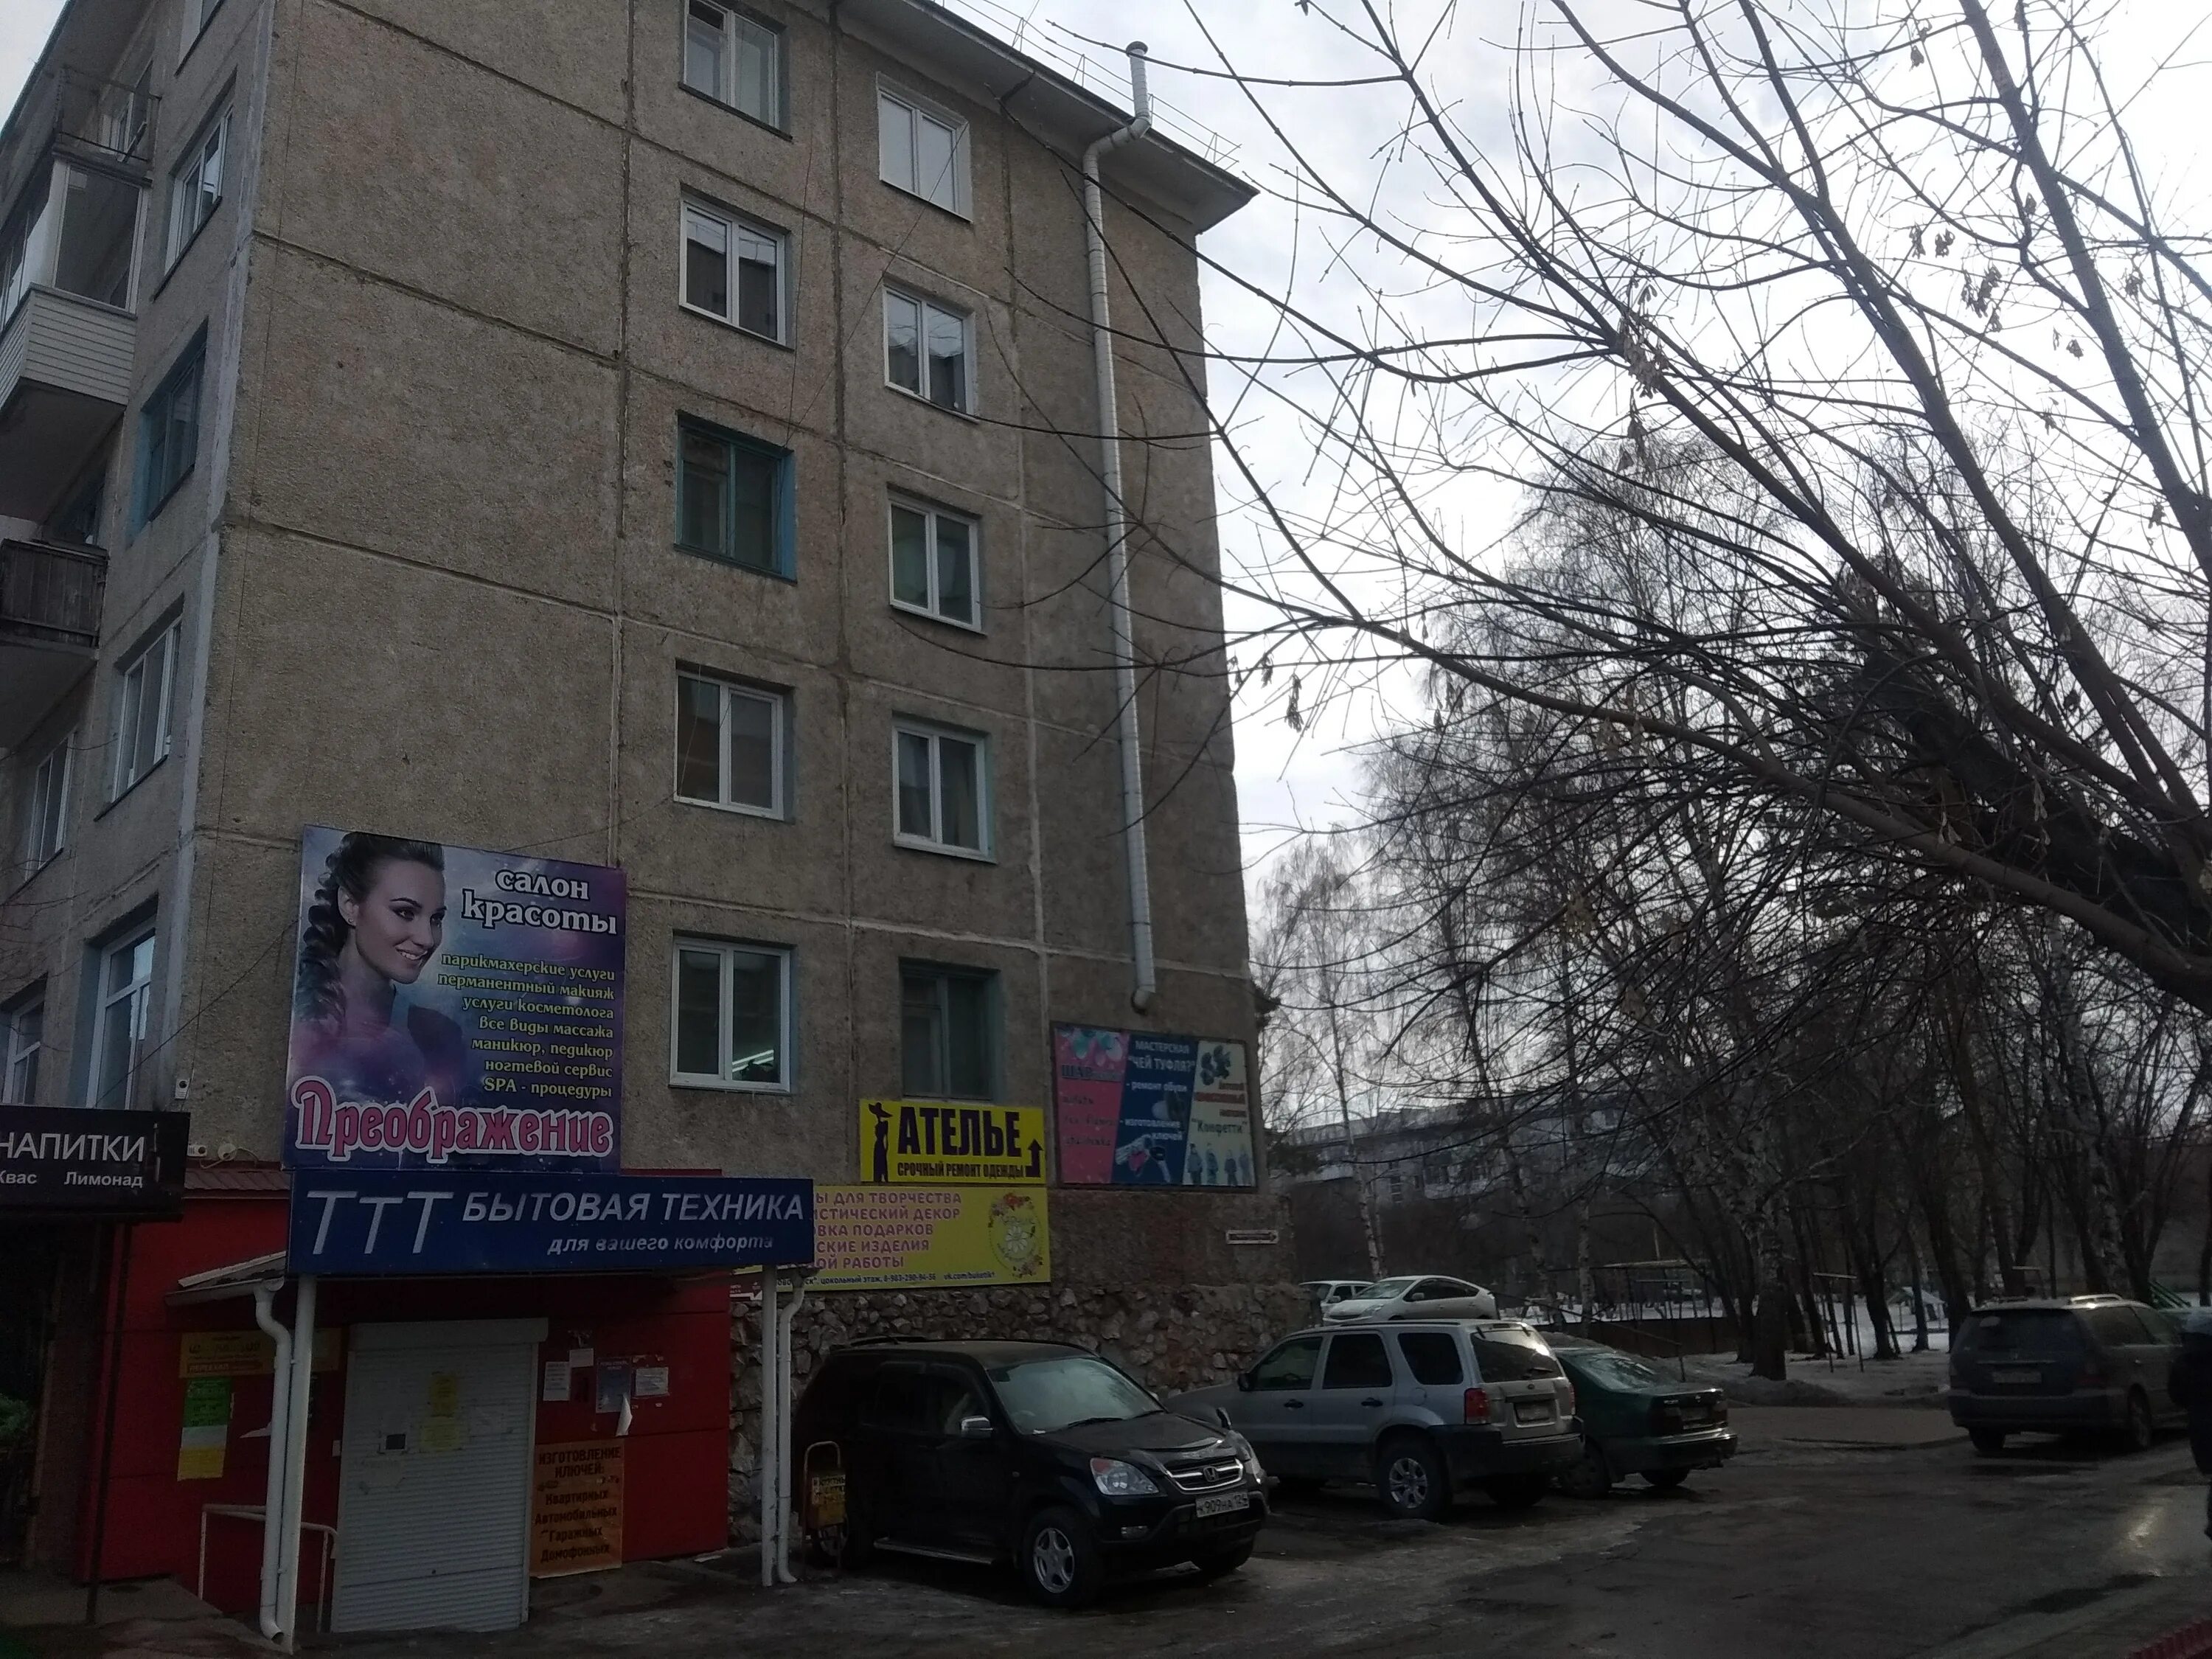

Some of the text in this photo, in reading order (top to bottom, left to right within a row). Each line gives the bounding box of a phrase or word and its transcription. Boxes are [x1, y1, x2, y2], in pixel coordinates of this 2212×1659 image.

[496, 870, 589, 900] салон
[462, 888, 617, 935] красоты
[442, 954, 615, 981] парикмахерские услуги
[438, 974, 615, 1000] перманентный макияж
[462, 997, 614, 1019] услуги косметолога
[509, 1018, 549, 1036] виды
[553, 1023, 613, 1038] массажа
[472, 1038, 613, 1060] маникюр, педикюр
[485, 1060, 613, 1079] ногтевой сервис
[484, 1077, 518, 1092] SPA
[531, 1082, 612, 1099] процедуры
[294, 1079, 612, 1161] Преображение
[897, 1106, 1022, 1157] АТЕЛЬЕ
[64, 1171, 144, 1188] Лимонад
[897, 1161, 1023, 1179] СРОЧНЫЙ РЕМОНТ ОДЕЖДЫ
[462, 1192, 651, 1222] БЫТОВАЯ
[661, 1192, 804, 1221] ТЕХНИКА
[816, 1192, 961, 1205] Ы ДЛЯ ТВОРЧЕСТВА
[914, 1208, 960, 1221] ДЕКОР
[817, 1224, 933, 1237] ВКА ПОДАРКОВ
[547, 1233, 773, 1256] для вашего комфорта
[816, 1239, 929, 1253] СКИЕ ИЗДЕЛИЯ
[816, 1254, 903, 1269] ОЙ РАБОТЫ
[538, 1447, 622, 1465] ИЗГОТОВЛЕНИЕ
[545, 1490, 608, 1506] Квартирных
